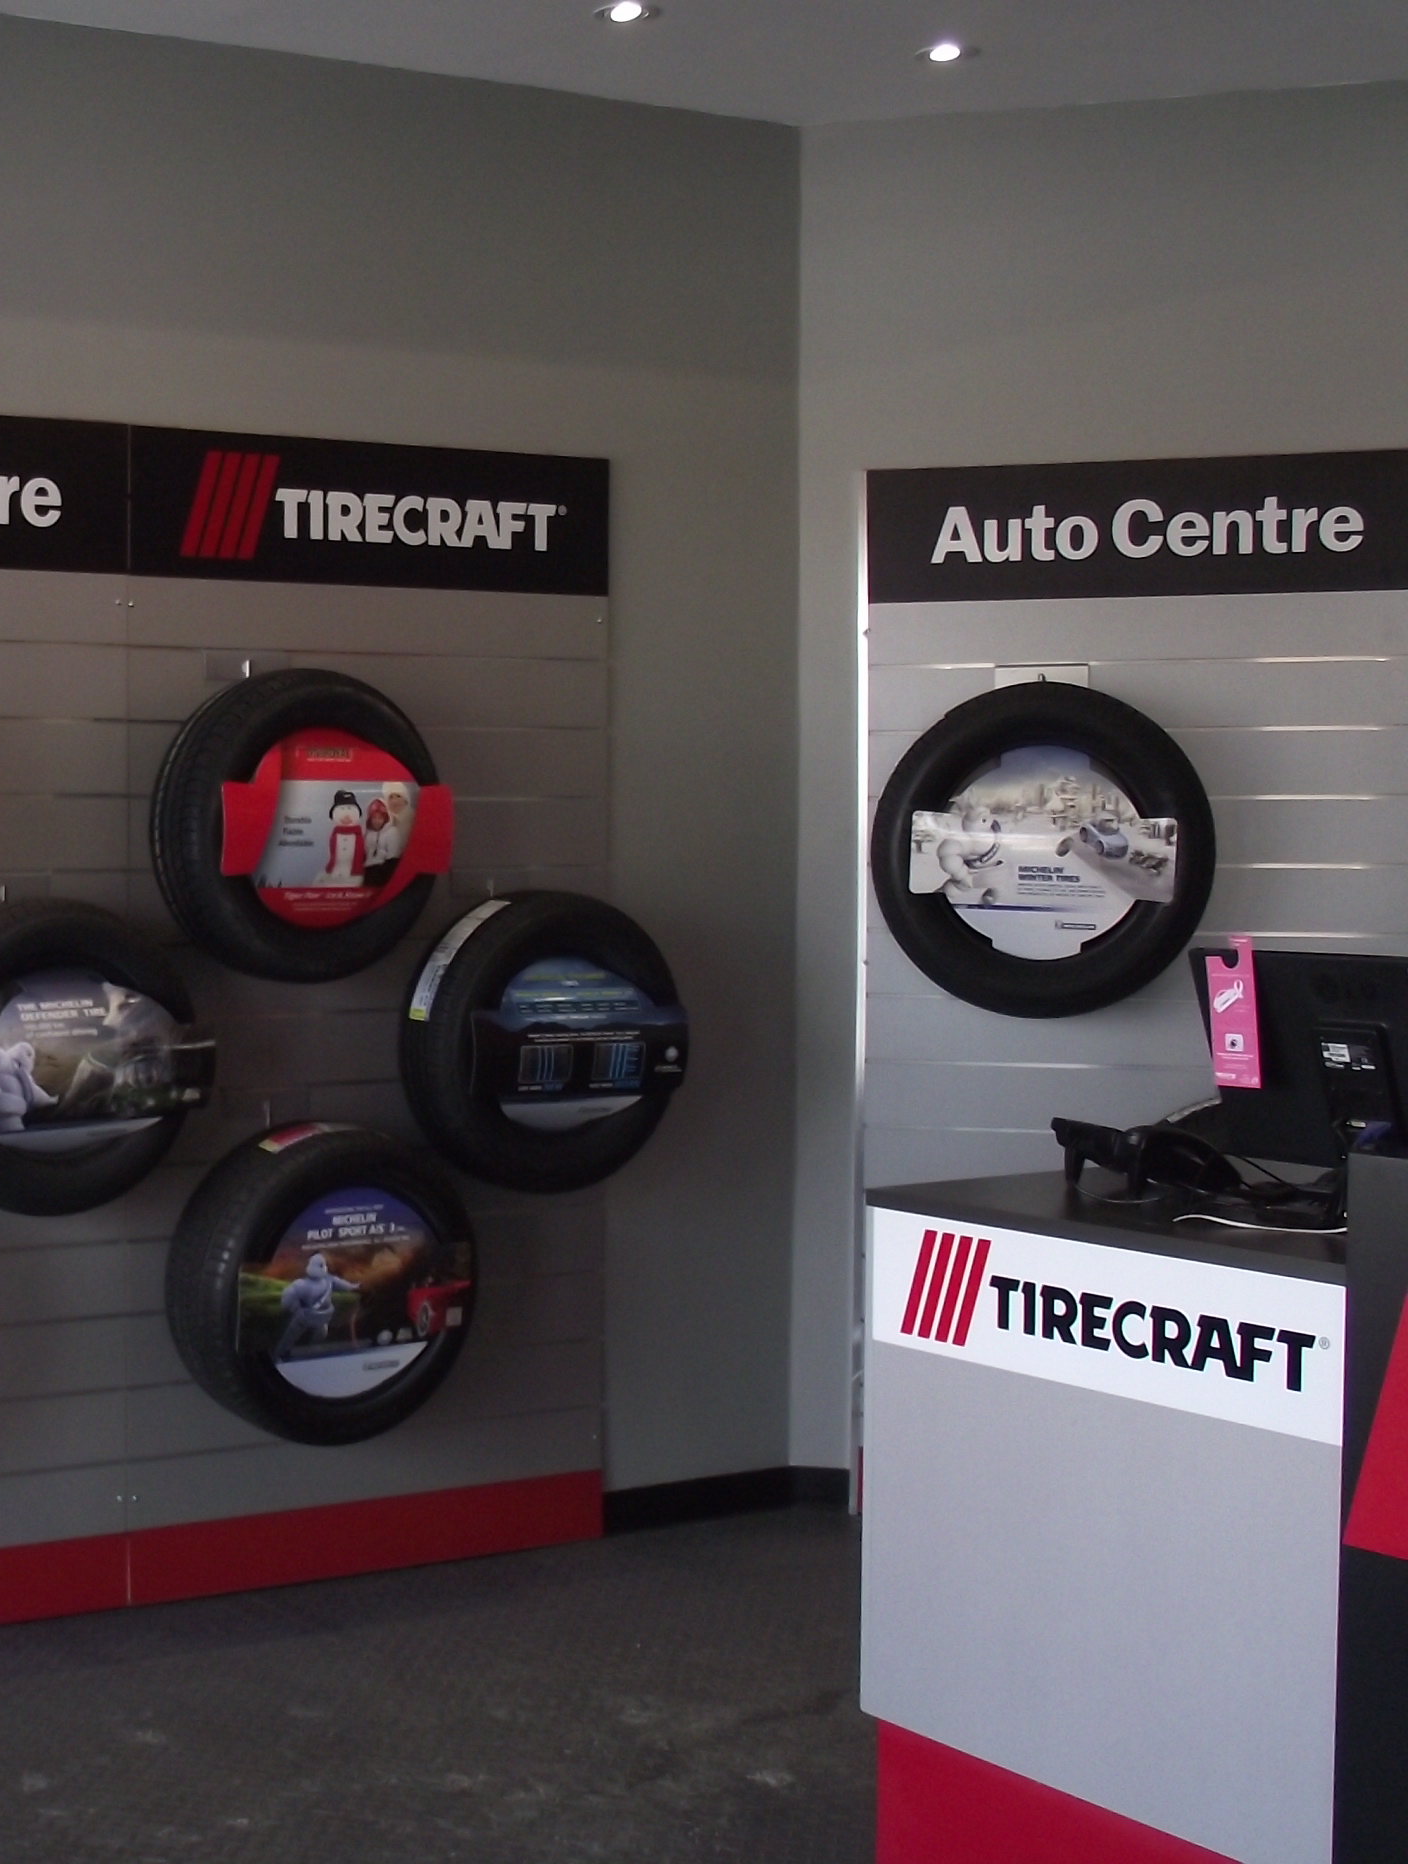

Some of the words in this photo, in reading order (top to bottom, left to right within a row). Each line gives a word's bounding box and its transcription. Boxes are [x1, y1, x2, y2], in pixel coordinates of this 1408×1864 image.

[274, 487, 558, 552] TIRECRAFT
[930, 504, 1100, 564] Auto
[1111, 496, 1365, 559] Centre
[1017, 865, 1065, 874] MICHELIN
[1018, 873, 1053, 882] WINTER
[1056, 874, 1081, 883] TIRES
[20, 1009, 79, 1022] DEFENDER
[332, 1213, 377, 1225] MICHELIN
[306, 1228, 334, 1241] PILOT
[338, 1225, 368, 1238] SPORT
[989, 1275, 1317, 1393] TIRECRAFT
